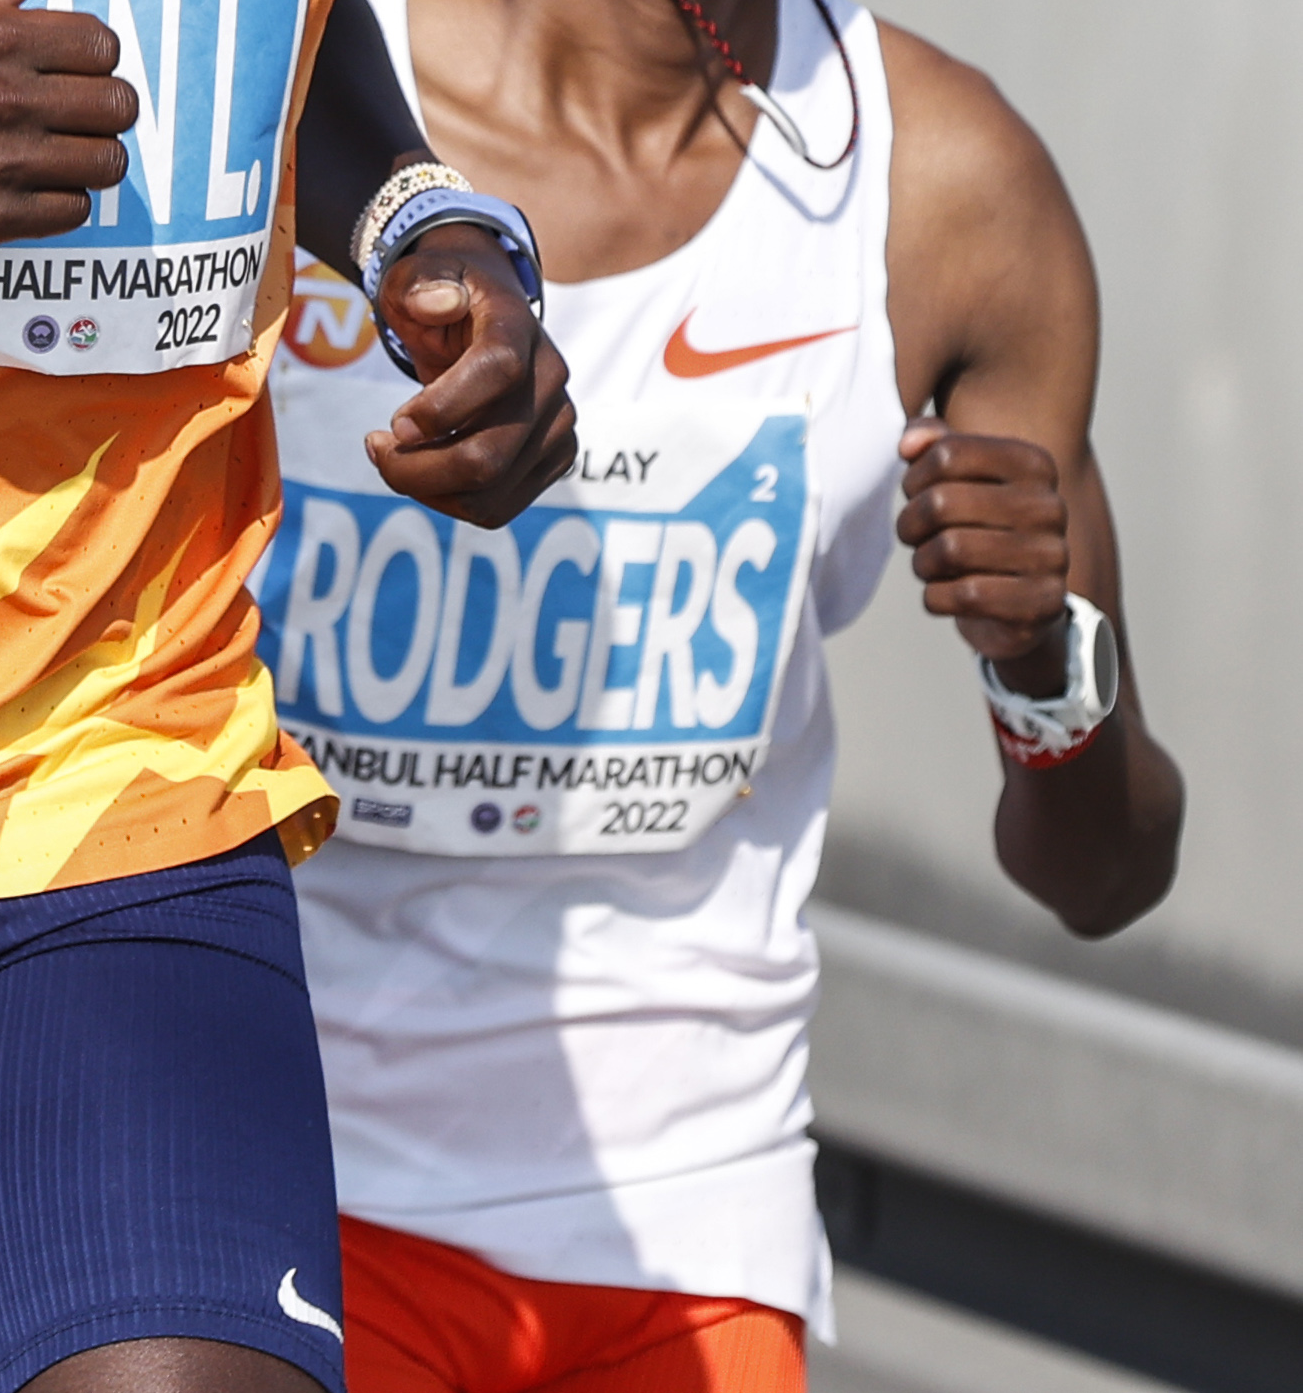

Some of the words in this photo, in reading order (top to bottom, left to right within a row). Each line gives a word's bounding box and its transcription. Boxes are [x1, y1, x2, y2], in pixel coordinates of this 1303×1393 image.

[90, 241, 262, 300] MARATHON
[155, 304, 222, 351] 2022
[562, 449, 658, 484] LAY
[749, 462, 780, 503] 2
[277, 496, 778, 732] RODGERS
[433, 754, 533, 789] HALF
[536, 749, 757, 794] MARATHON
[600, 800, 690, 835] 2022
